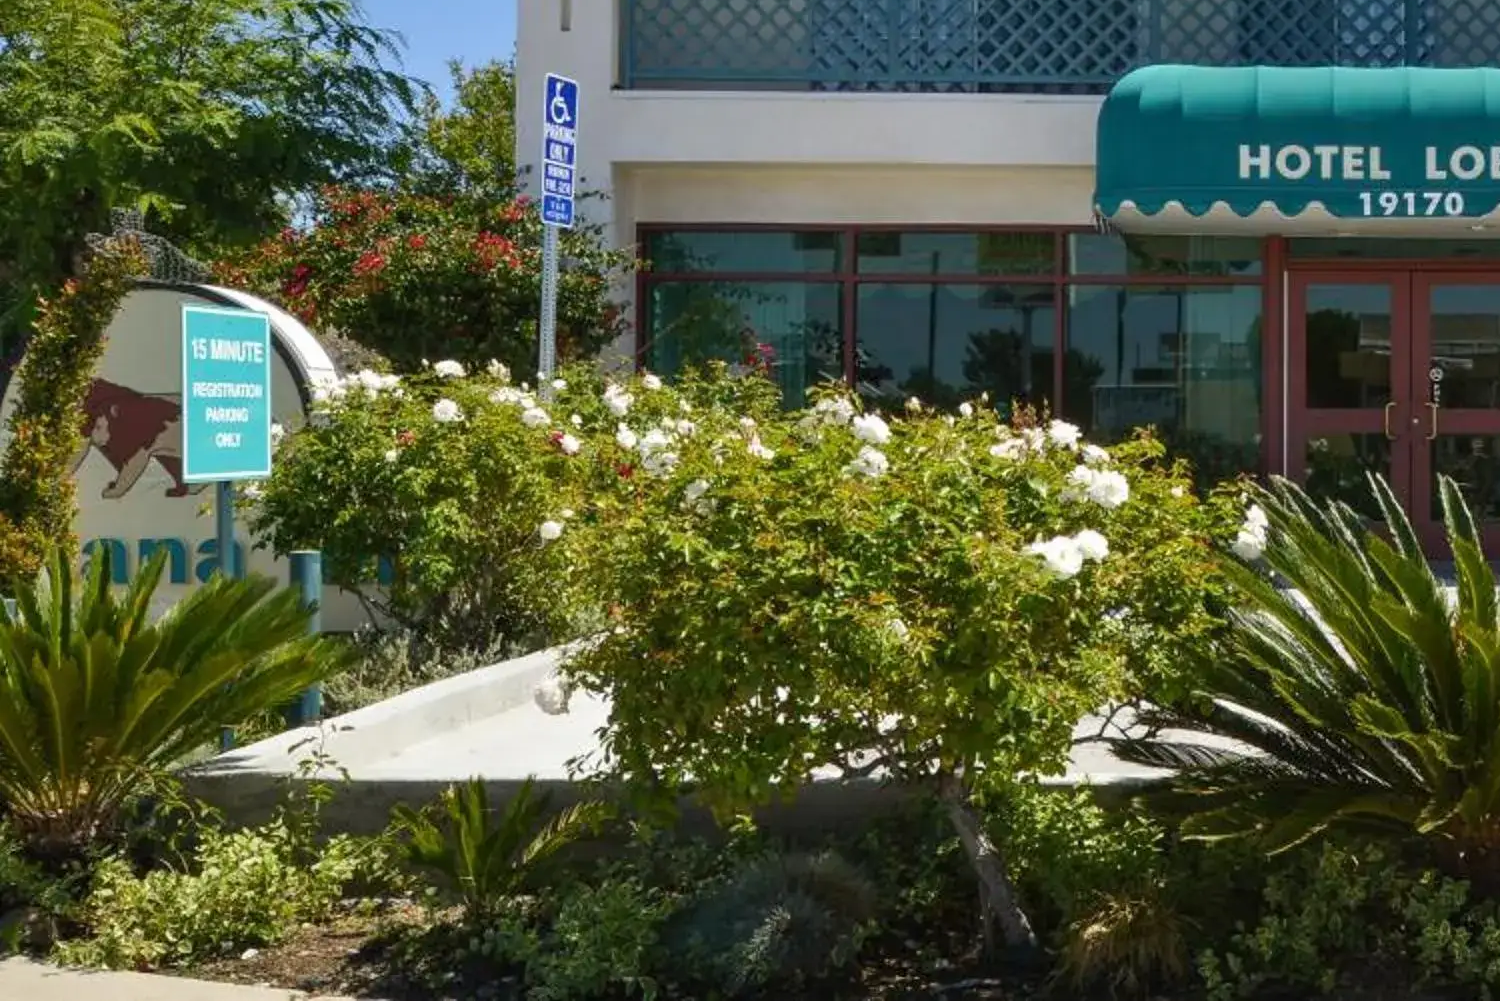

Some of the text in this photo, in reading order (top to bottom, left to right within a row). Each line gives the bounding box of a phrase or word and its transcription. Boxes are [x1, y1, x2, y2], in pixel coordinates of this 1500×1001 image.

[1238, 144, 1391, 182] HOTEL
[1359, 192, 1464, 217] 19170
[192, 337, 264, 364] 15 MINUTE
[192, 381, 263, 399] REGISTRATION
[205, 406, 249, 423] PARKING
[215, 432, 242, 448] ONLY
